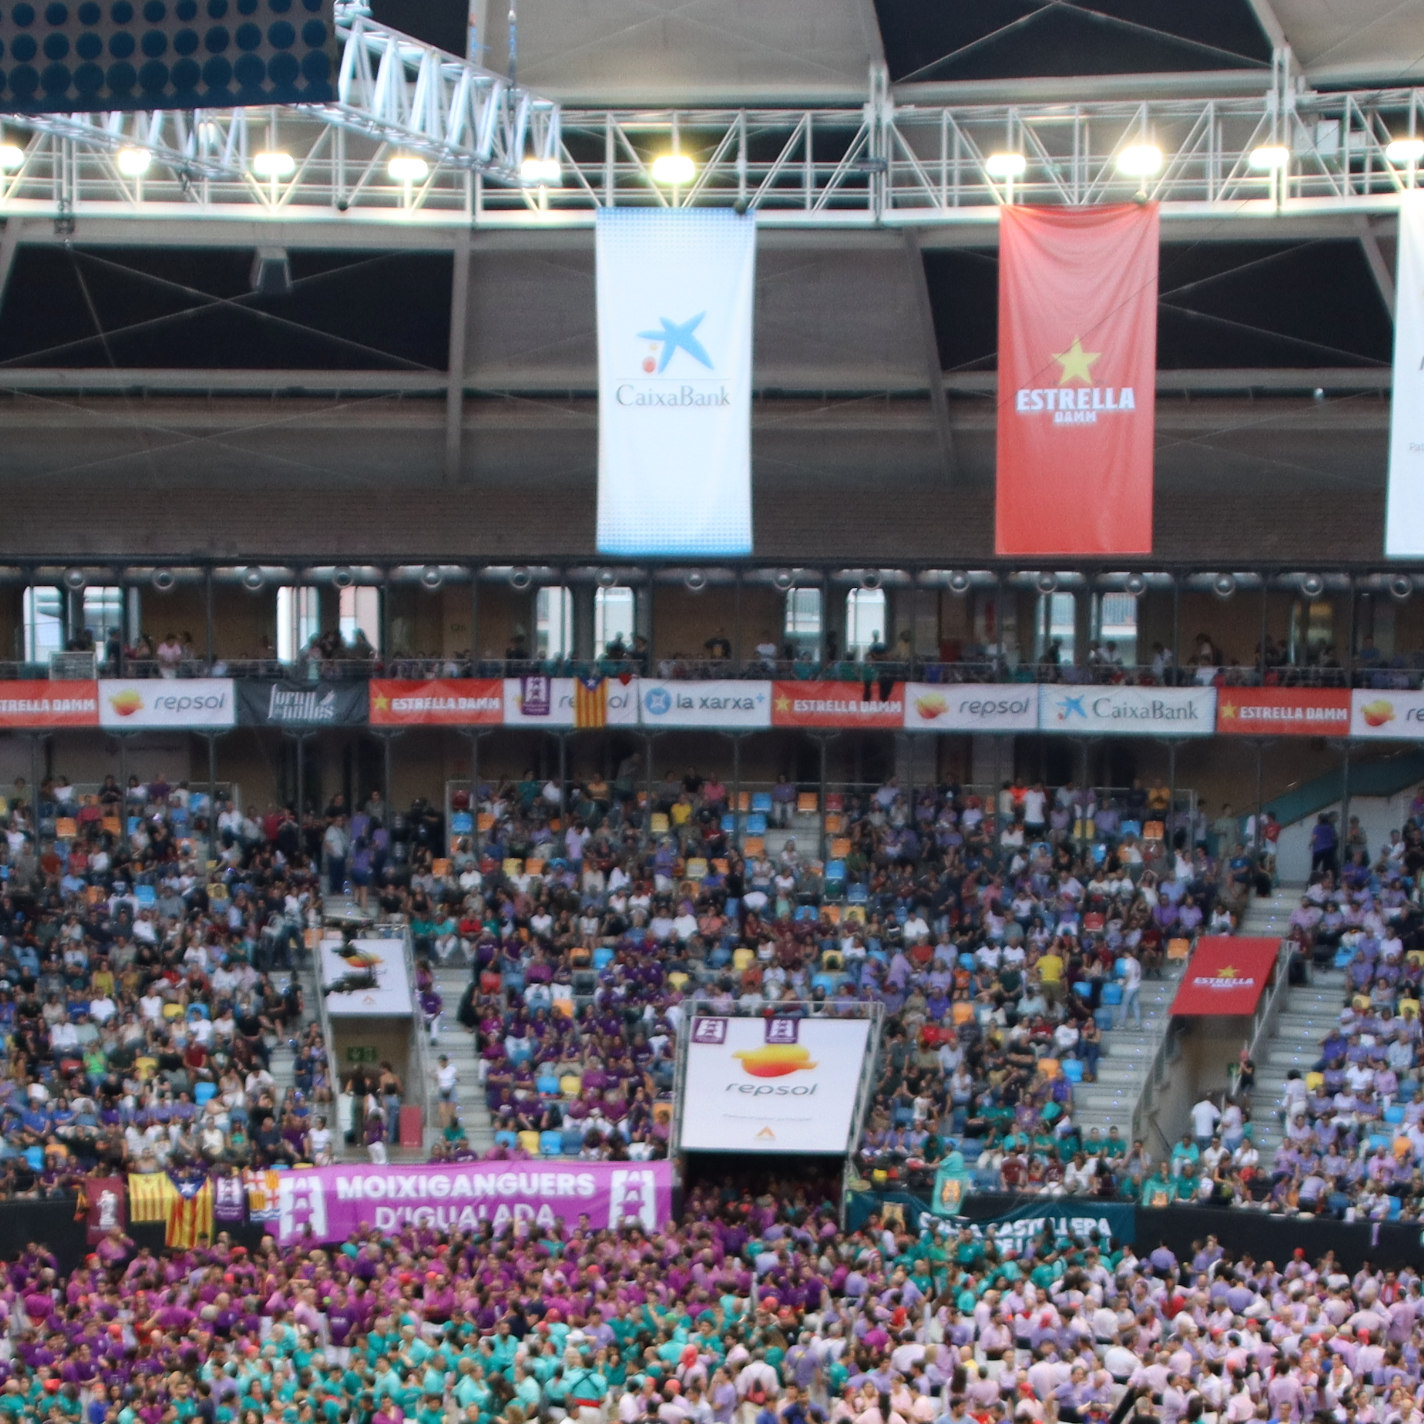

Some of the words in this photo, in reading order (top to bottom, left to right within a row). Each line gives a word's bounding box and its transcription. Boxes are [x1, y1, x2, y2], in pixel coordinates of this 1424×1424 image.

[615, 384, 731, 407] CaixaBank
[1017, 387, 1136, 411] ESTRELLA
[1054, 410, 1097, 423] DAMM
[52, 698, 94, 712] DAMM
[154, 693, 225, 713] repsol
[391, 697, 456, 711] ESTRELLA
[458, 696, 500, 710] DAMM
[559, 693, 628, 709] reol
[677, 693, 694, 709] la
[793, 699, 860, 713] ESTRELLA
[860, 700, 901, 713] DAMM
[959, 697, 1030, 717] repsol
[1092, 697, 1198, 720] CaixaBank
[1240, 706, 1304, 720] ESTRELLA
[1306, 707, 1347, 720] DAMM
[1193, 977, 1254, 985] ESTRELLA
[725, 1083, 818, 1097] repsol
[336, 1172, 596, 1200] MOIXIGANGUERS
